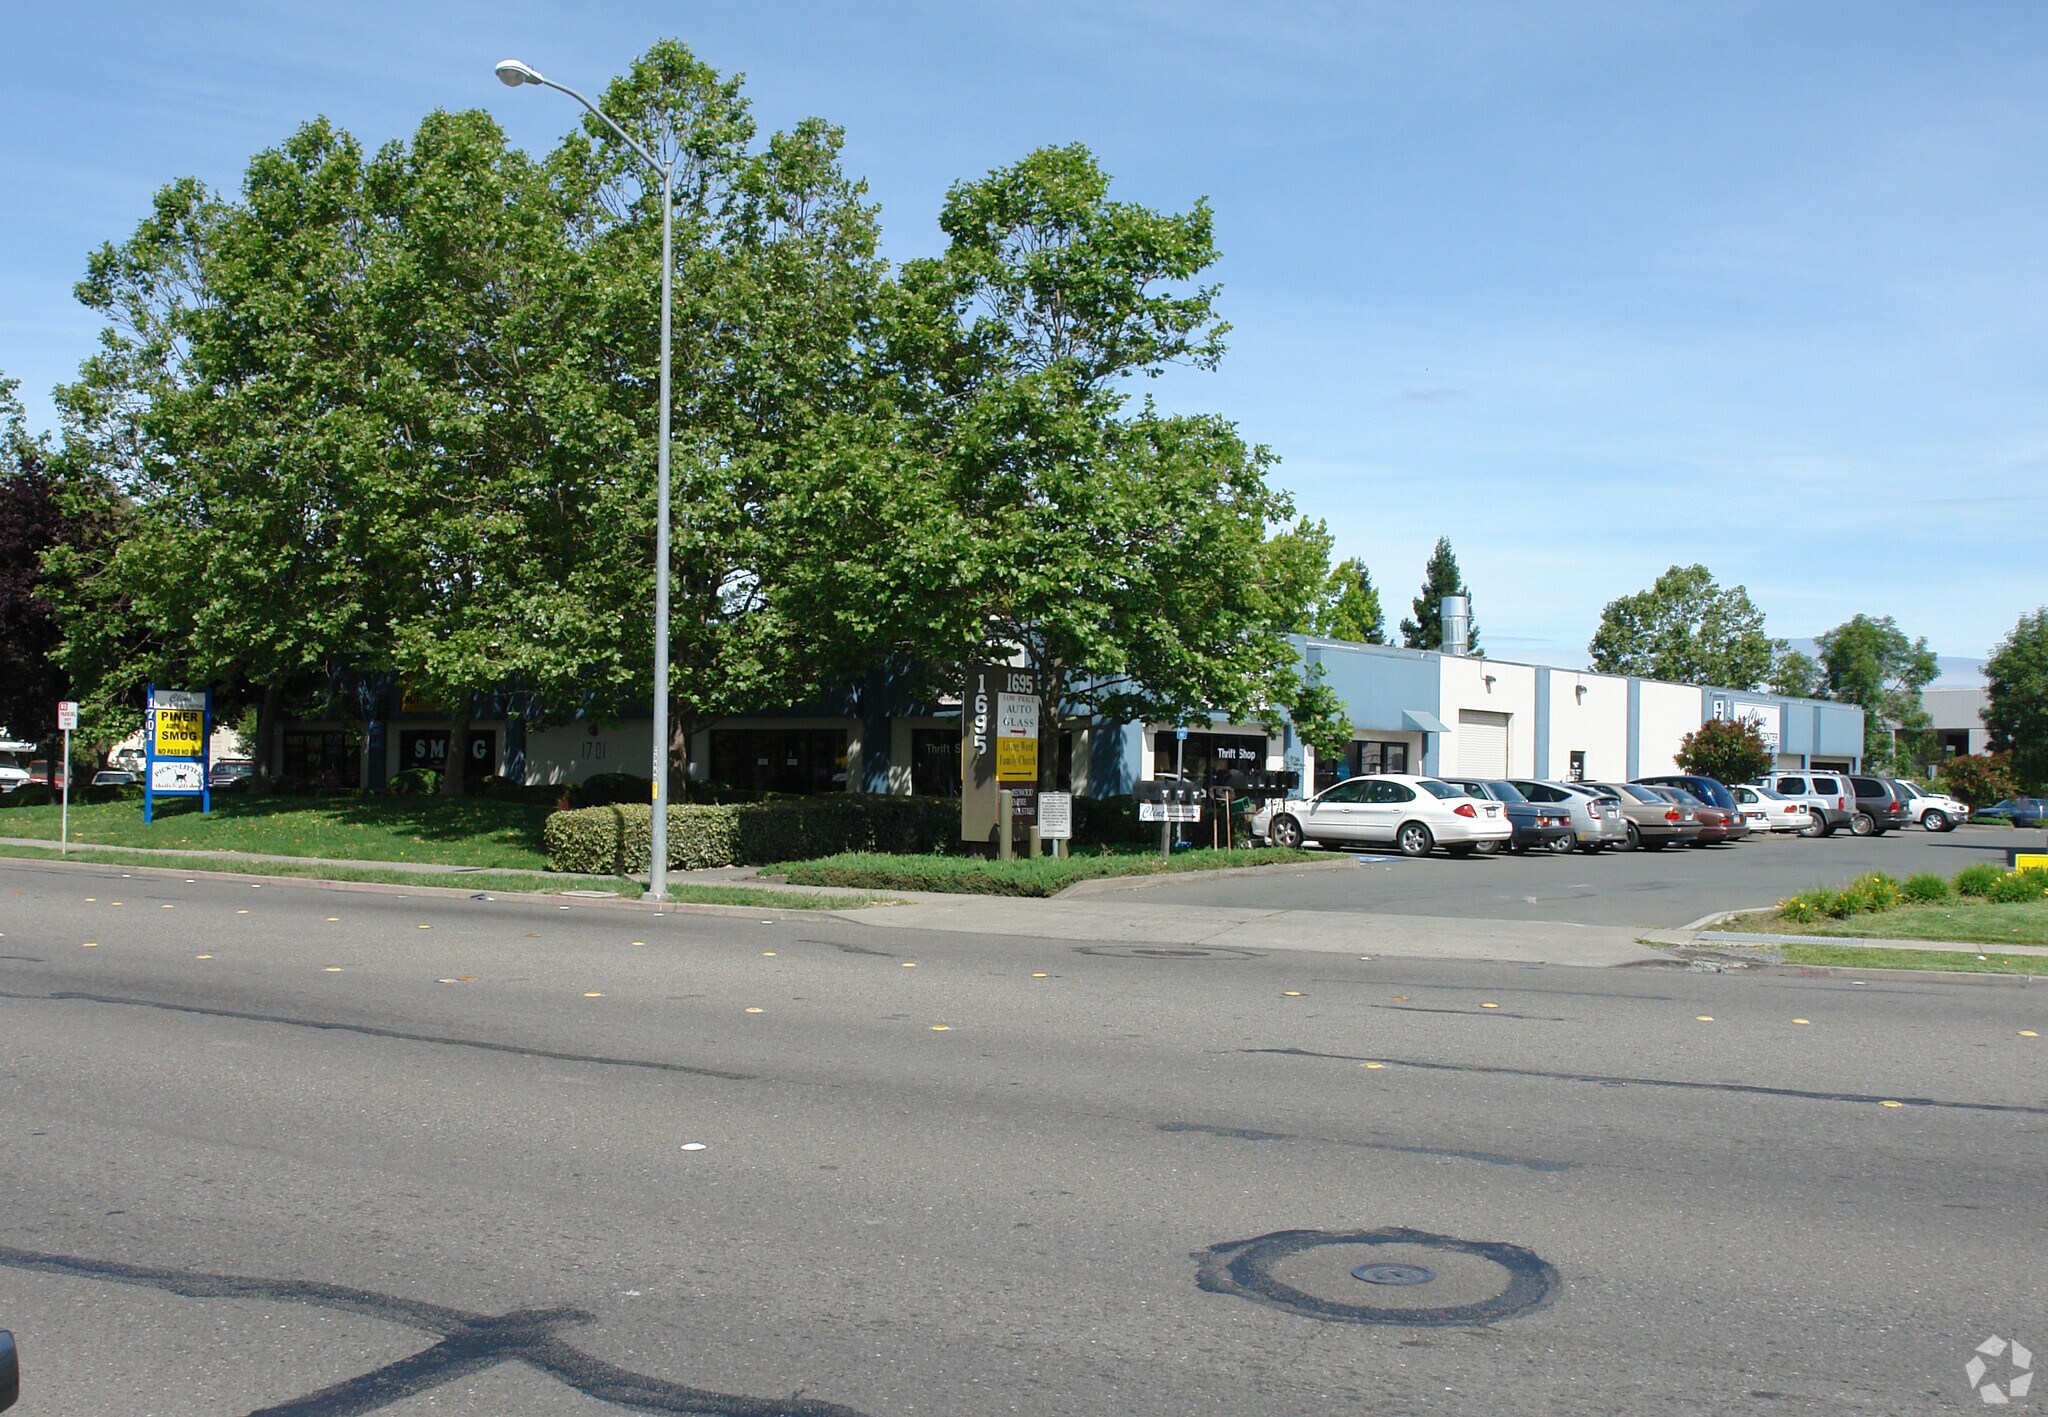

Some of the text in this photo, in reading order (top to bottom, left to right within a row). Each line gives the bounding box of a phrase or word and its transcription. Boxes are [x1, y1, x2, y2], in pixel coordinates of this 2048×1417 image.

[1006, 673, 1033, 694] 1695
[1018, 695, 1035, 703] PRICE
[973, 673, 988, 755] 1695
[1006, 705, 1032, 714] AUTO
[161, 711, 198, 722] PINER
[1003, 717, 1034, 728] GLASS
[161, 731, 197, 740] SMOG
[415, 739, 487, 760] SMG
[582, 741, 606, 759] 1701
[926, 743, 950, 755] Thrift
[1003, 741, 1034, 752] Living Word
[1217, 748, 1256, 761] Thrift Shop
[1000, 755, 1036, 767] Family Church
